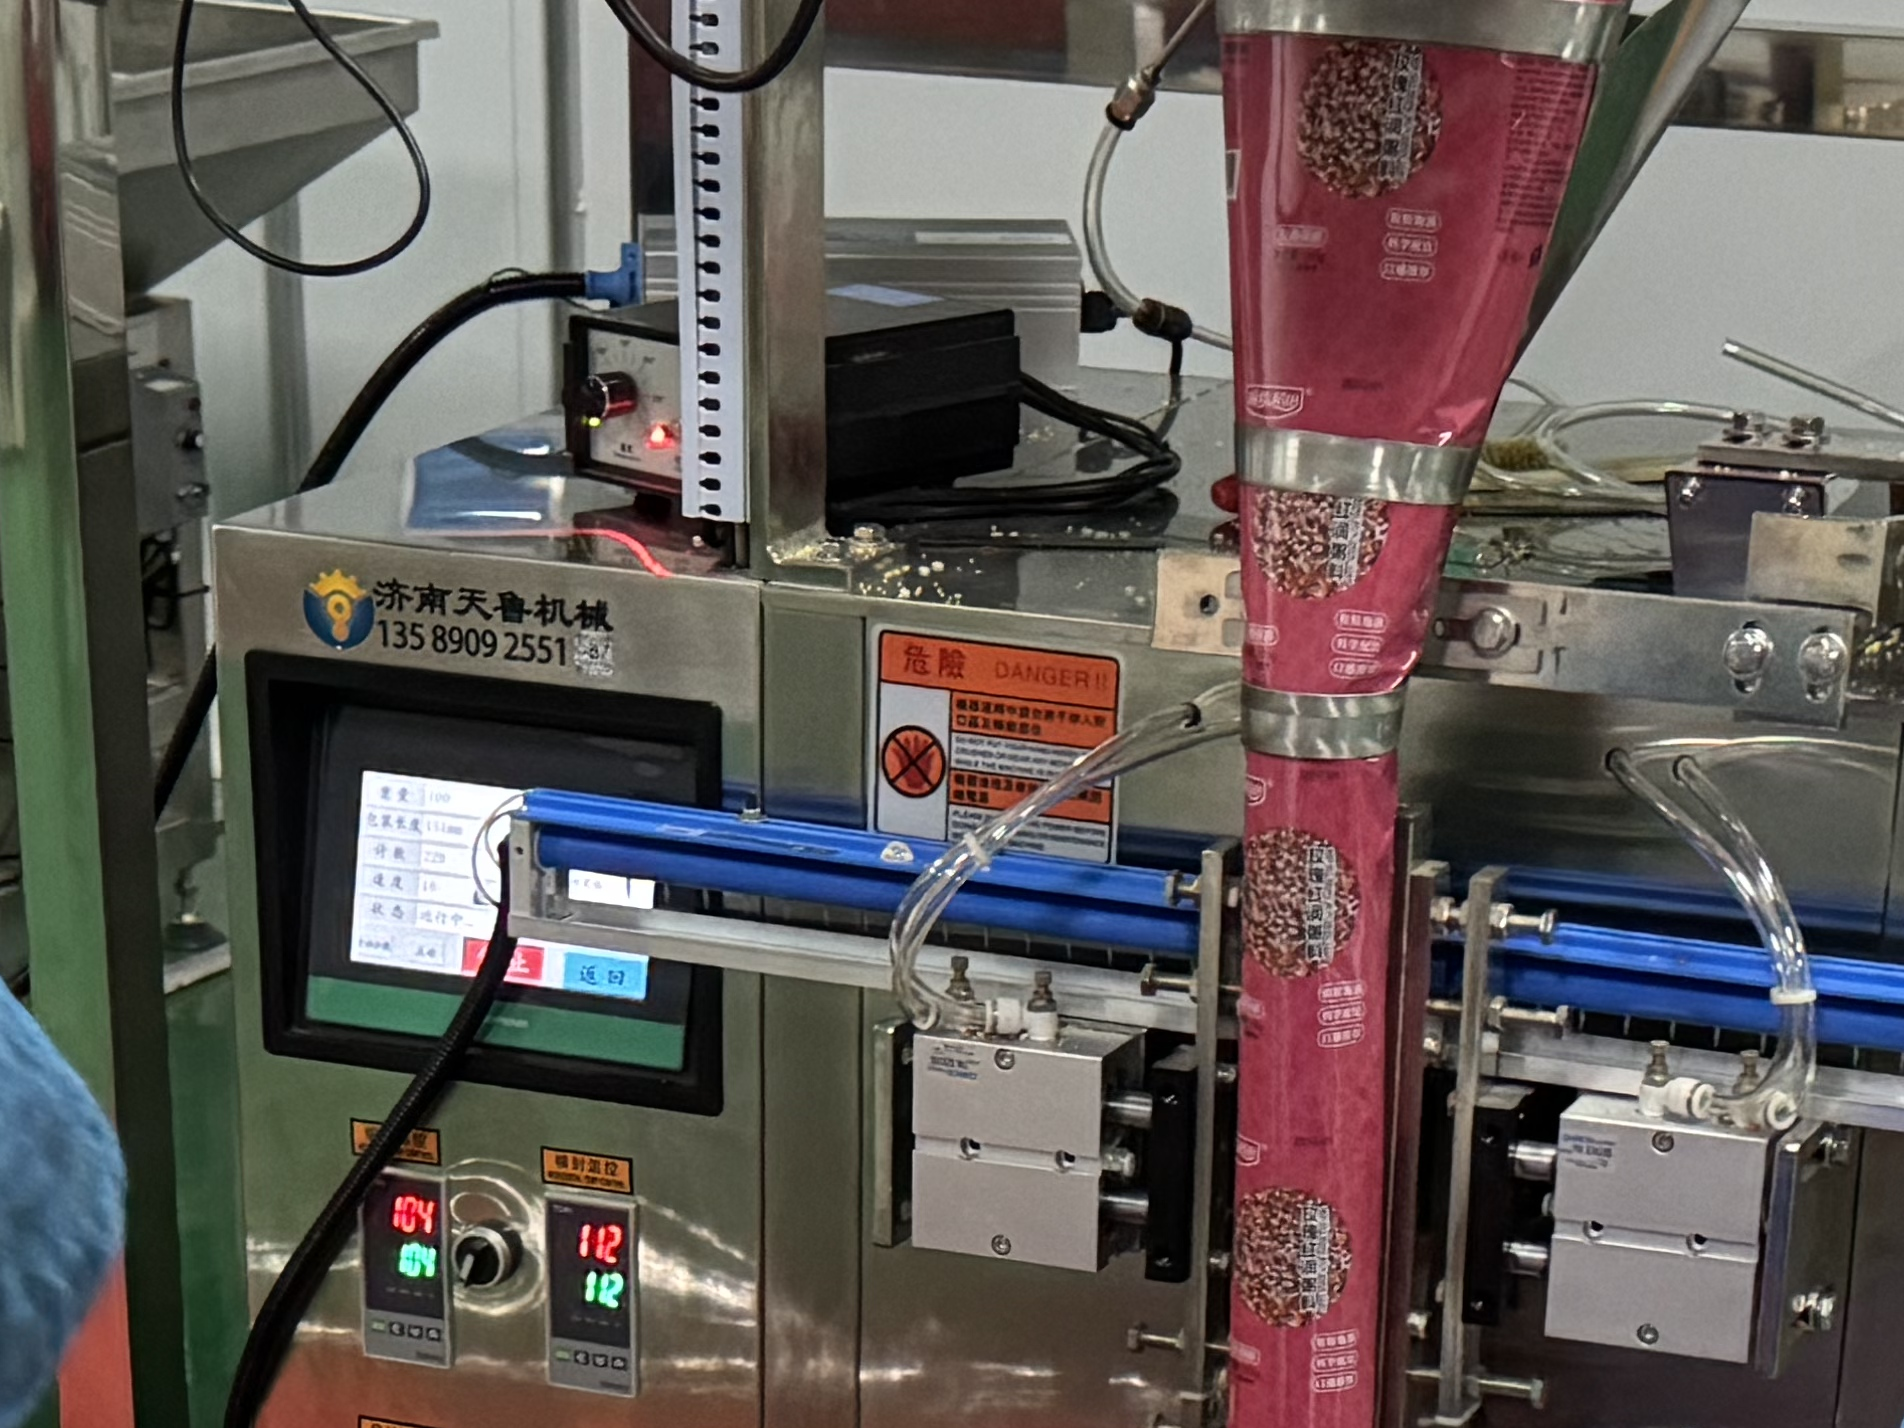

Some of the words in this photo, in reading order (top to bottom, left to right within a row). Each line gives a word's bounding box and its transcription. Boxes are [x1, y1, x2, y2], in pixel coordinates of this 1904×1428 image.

[373, 579, 614, 632] 济南天鲁机械
[377, 620, 424, 651] 135
[433, 624, 497, 658] 8909
[504, 632, 567, 667] 2551
[995, 660, 1090, 690] DANGER
[580, 963, 626, 987] 返回
